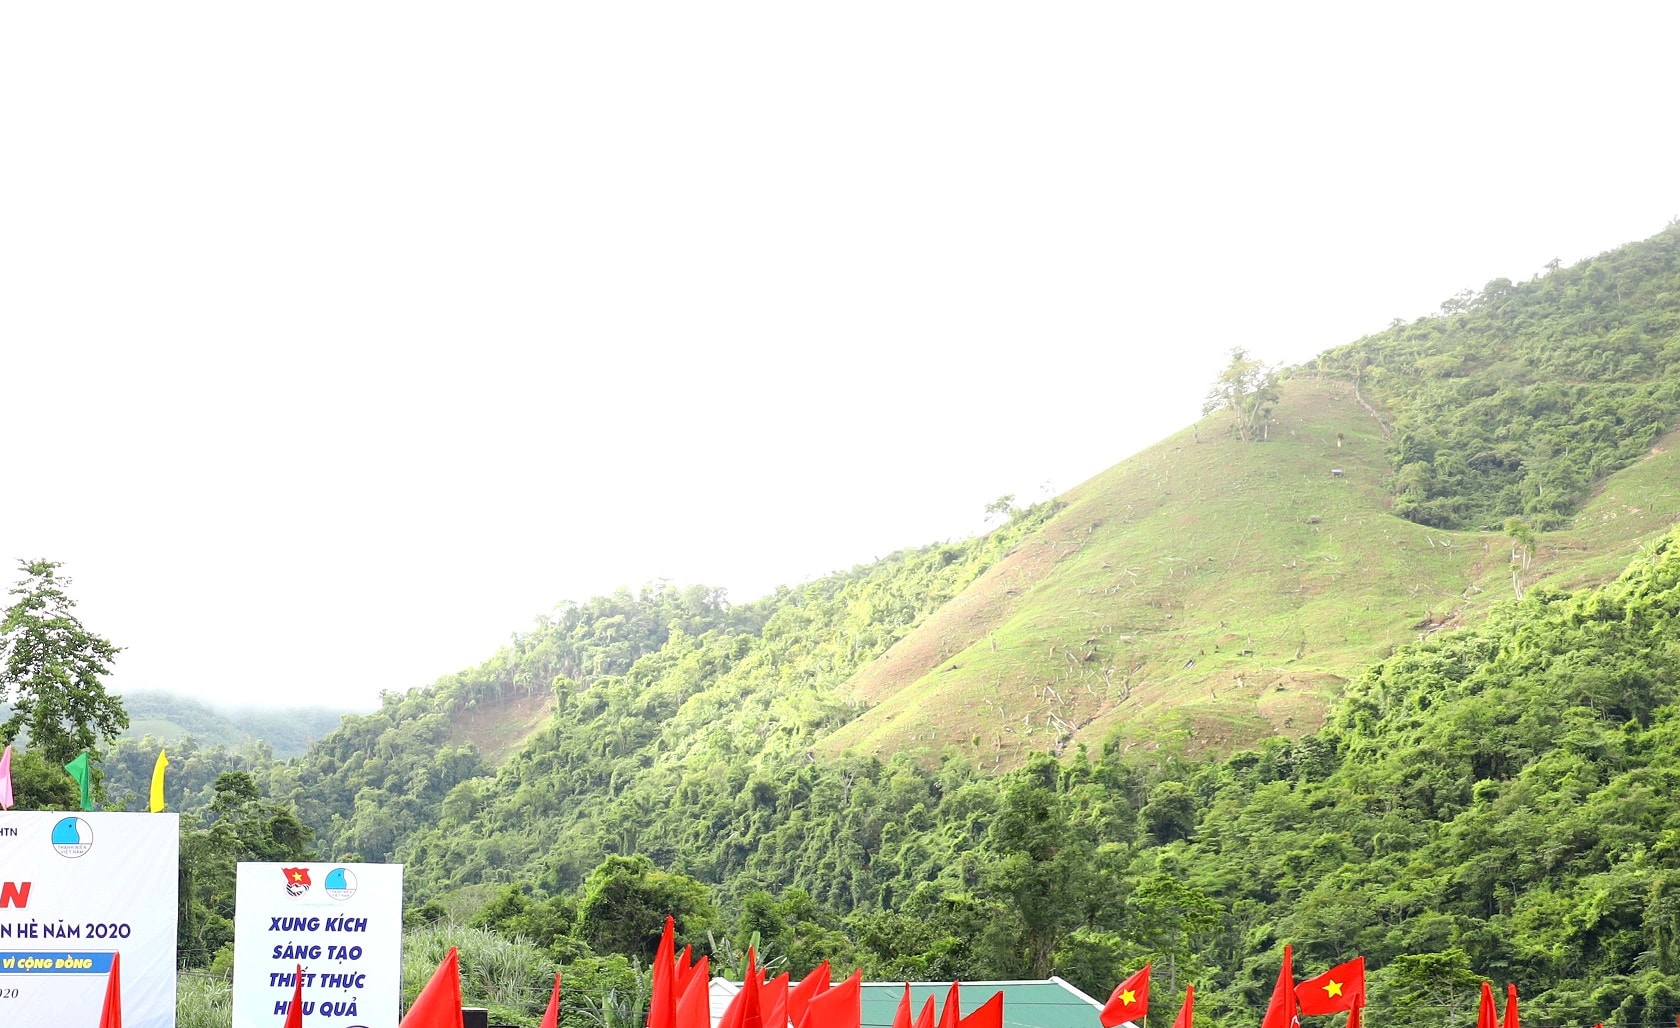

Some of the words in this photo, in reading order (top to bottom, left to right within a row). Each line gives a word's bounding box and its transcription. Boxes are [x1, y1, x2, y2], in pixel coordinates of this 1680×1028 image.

[17, 918, 39, 939] HÈ
[43, 919, 80, 939] NĂM
[85, 923, 131, 939] 2020
[268, 917, 320, 931] XUNG
[325, 913, 368, 932] KÍCH
[2, 955, 15, 969] VÌ
[17, 956, 53, 971] CỘNG
[55, 954, 93, 969] ĐỒNG
[272, 941, 322, 960] SÁNG
[328, 945, 362, 965] TẠO
[270, 966, 316, 987] THIẾT
[321, 971, 366, 993] THỰC
[319, 997, 357, 1018] QUẢ
